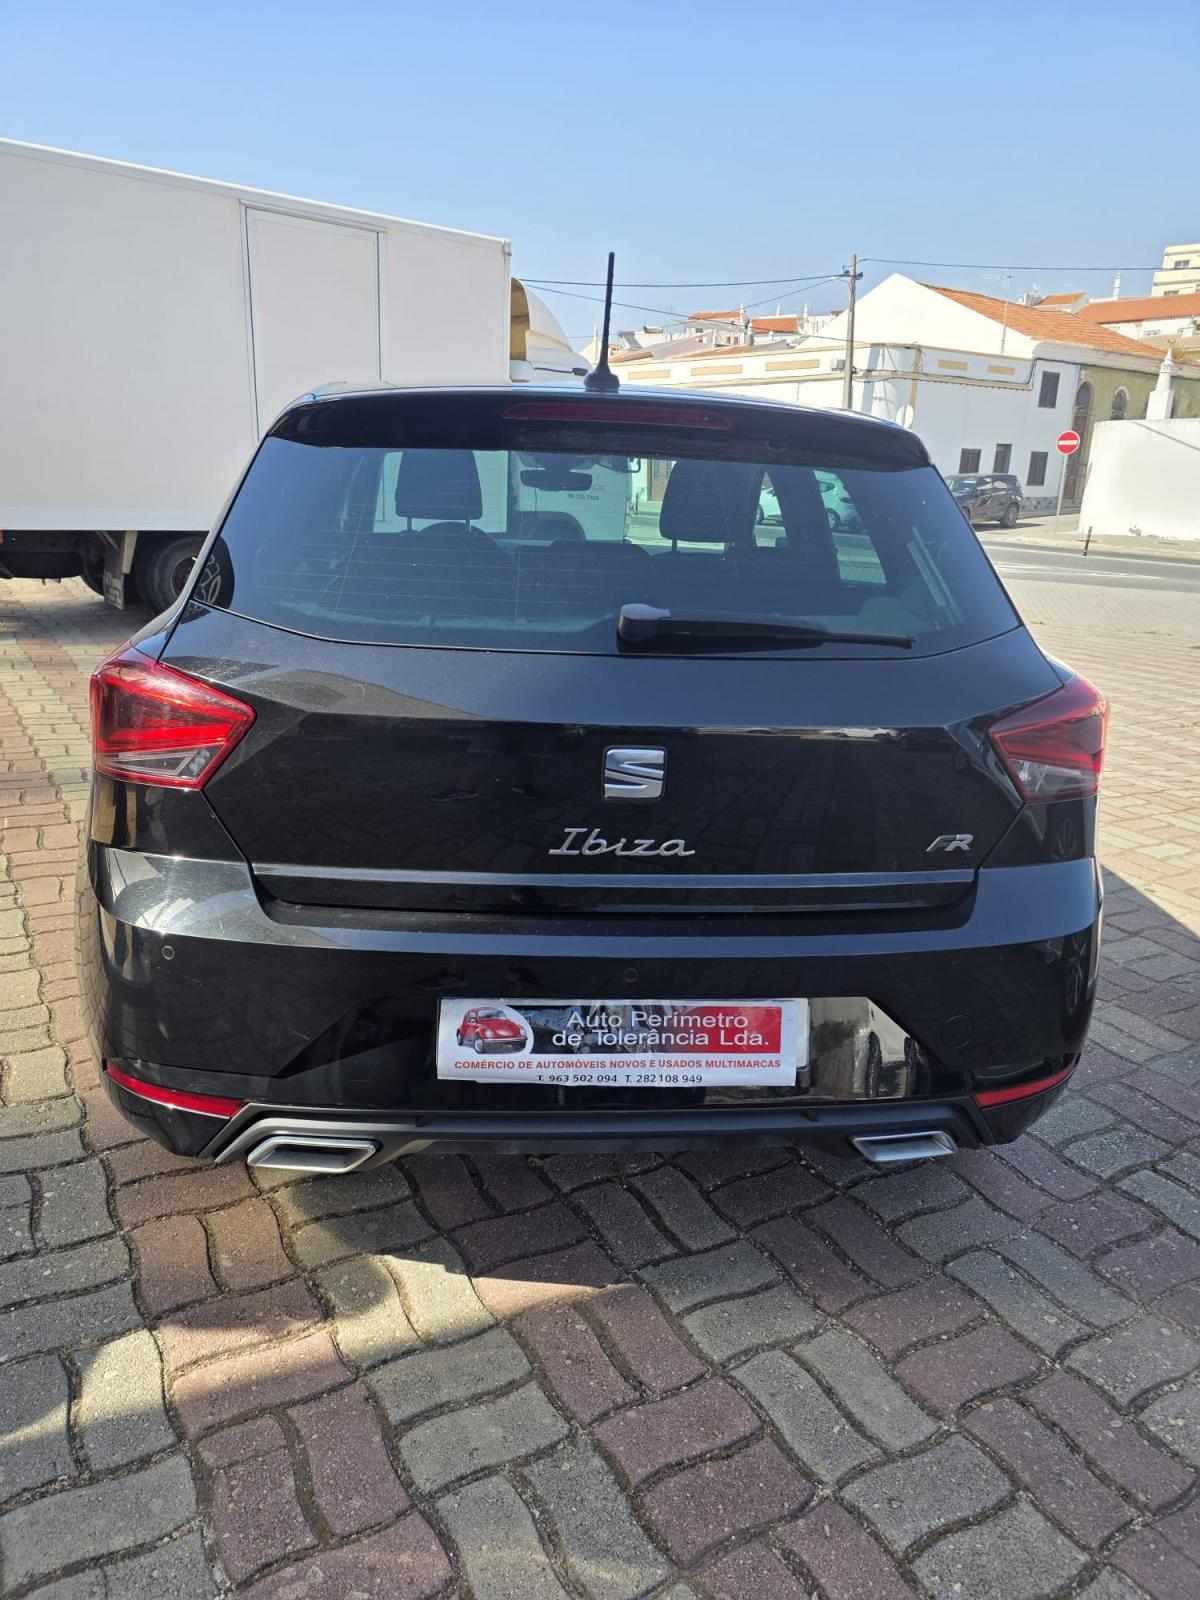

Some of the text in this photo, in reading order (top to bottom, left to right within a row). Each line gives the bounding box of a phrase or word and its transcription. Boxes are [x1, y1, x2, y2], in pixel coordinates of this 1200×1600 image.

[549, 827, 696, 857] Ibiza
[926, 833, 974, 853] FR
[566, 1010, 749, 1028] Auto Perímetro
[552, 1029, 769, 1046] de Tolerância Lda.
[454, 1059, 781, 1070] COMÉRCIO DE AUTOMÓVEIS NOVOS E USADOS MULTIMARCAS
[548, 1074, 570, 1083] 963
[573, 1074, 593, 1083] 502
[596, 1074, 618, 1083] 094
[624, 1074, 632, 1083] T.
[682, 1074, 703, 1083] 949
